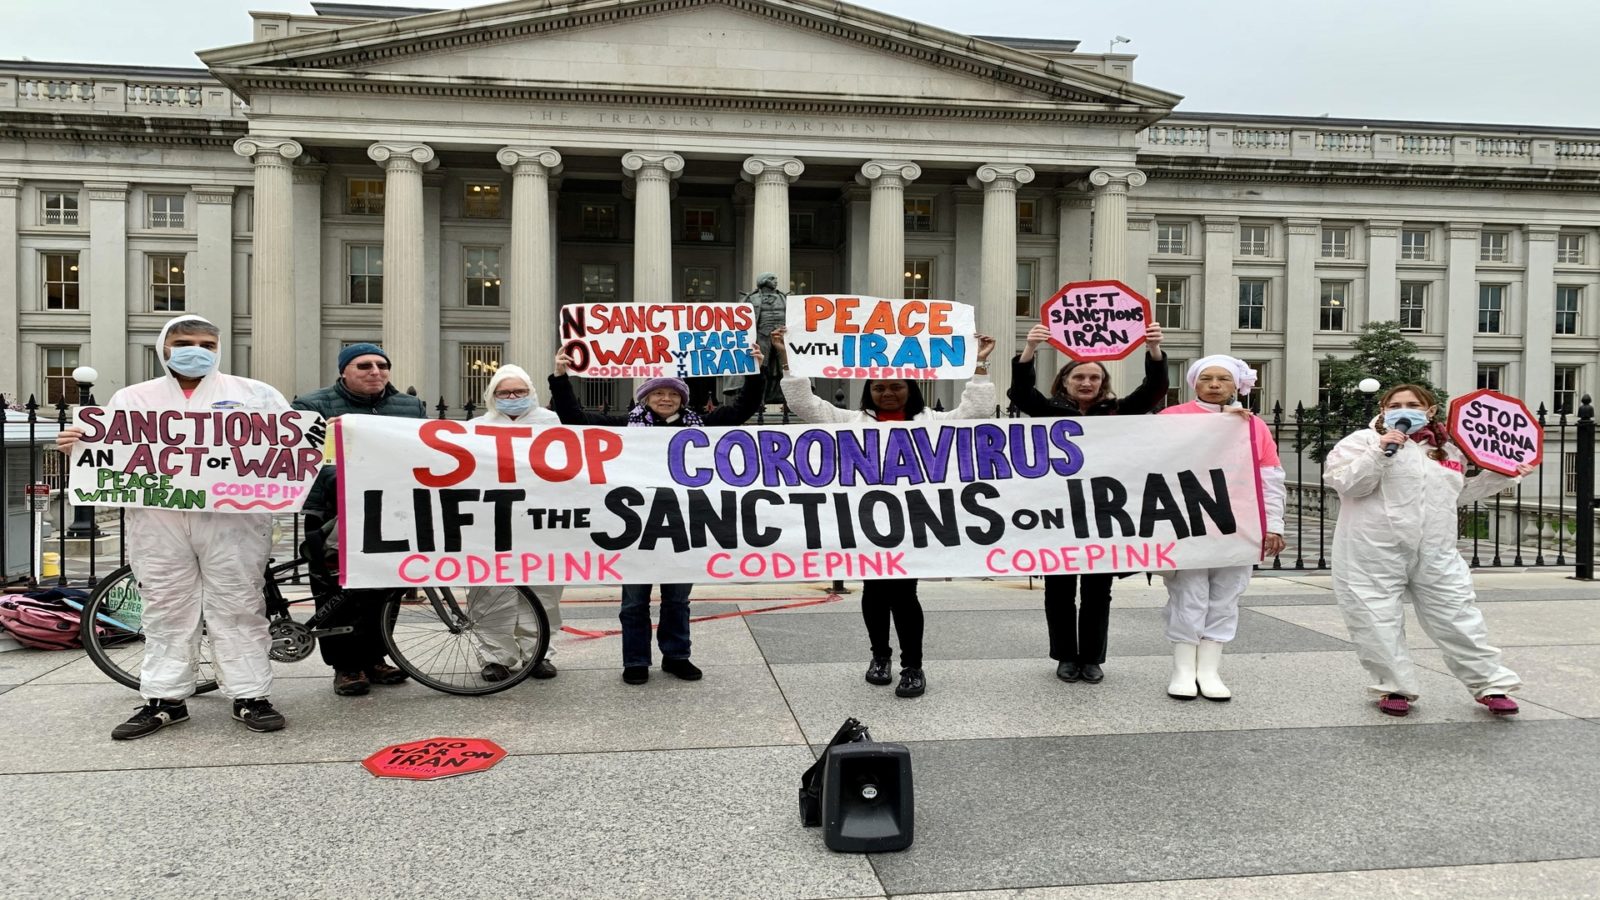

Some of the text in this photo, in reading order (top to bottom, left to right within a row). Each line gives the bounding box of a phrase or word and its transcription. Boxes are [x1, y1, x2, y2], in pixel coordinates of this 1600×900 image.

[529, 111, 890, 134] THE TREASURY DEPARTMENT
[1062, 292, 1120, 307] LIFT
[587, 304, 753, 334] SANCTIONS
[804, 297, 953, 336] PEACE
[1051, 307, 1143, 325] SANCTIONS
[1082, 322, 1109, 332] ON
[590, 335, 673, 366] WAR
[678, 331, 749, 351] PEACE
[842, 333, 966, 368] IRAN
[1064, 330, 1129, 347] IRAN
[690, 349, 755, 375] IRAN
[823, 366, 939, 379] CODEPINK
[78, 407, 327, 448] SANCTIONS ARE
[1466, 401, 1528, 431] STOP
[1462, 419, 1536, 453] CORONA
[1468, 434, 1525, 462] VIRUS
[77, 444, 323, 481] AN ACT OF WAR
[413, 419, 1084, 487] STOP CORONAVIRUS
[97, 468, 174, 489] PEACE
[74, 488, 206, 509] WITH IRAN
[361, 468, 1237, 553] LIFT THE SANCTIONS ON IRAN
[398, 542, 1178, 583] CODEPINK CODEPINK CODEPINK
[388, 755, 469, 767] IRAN
